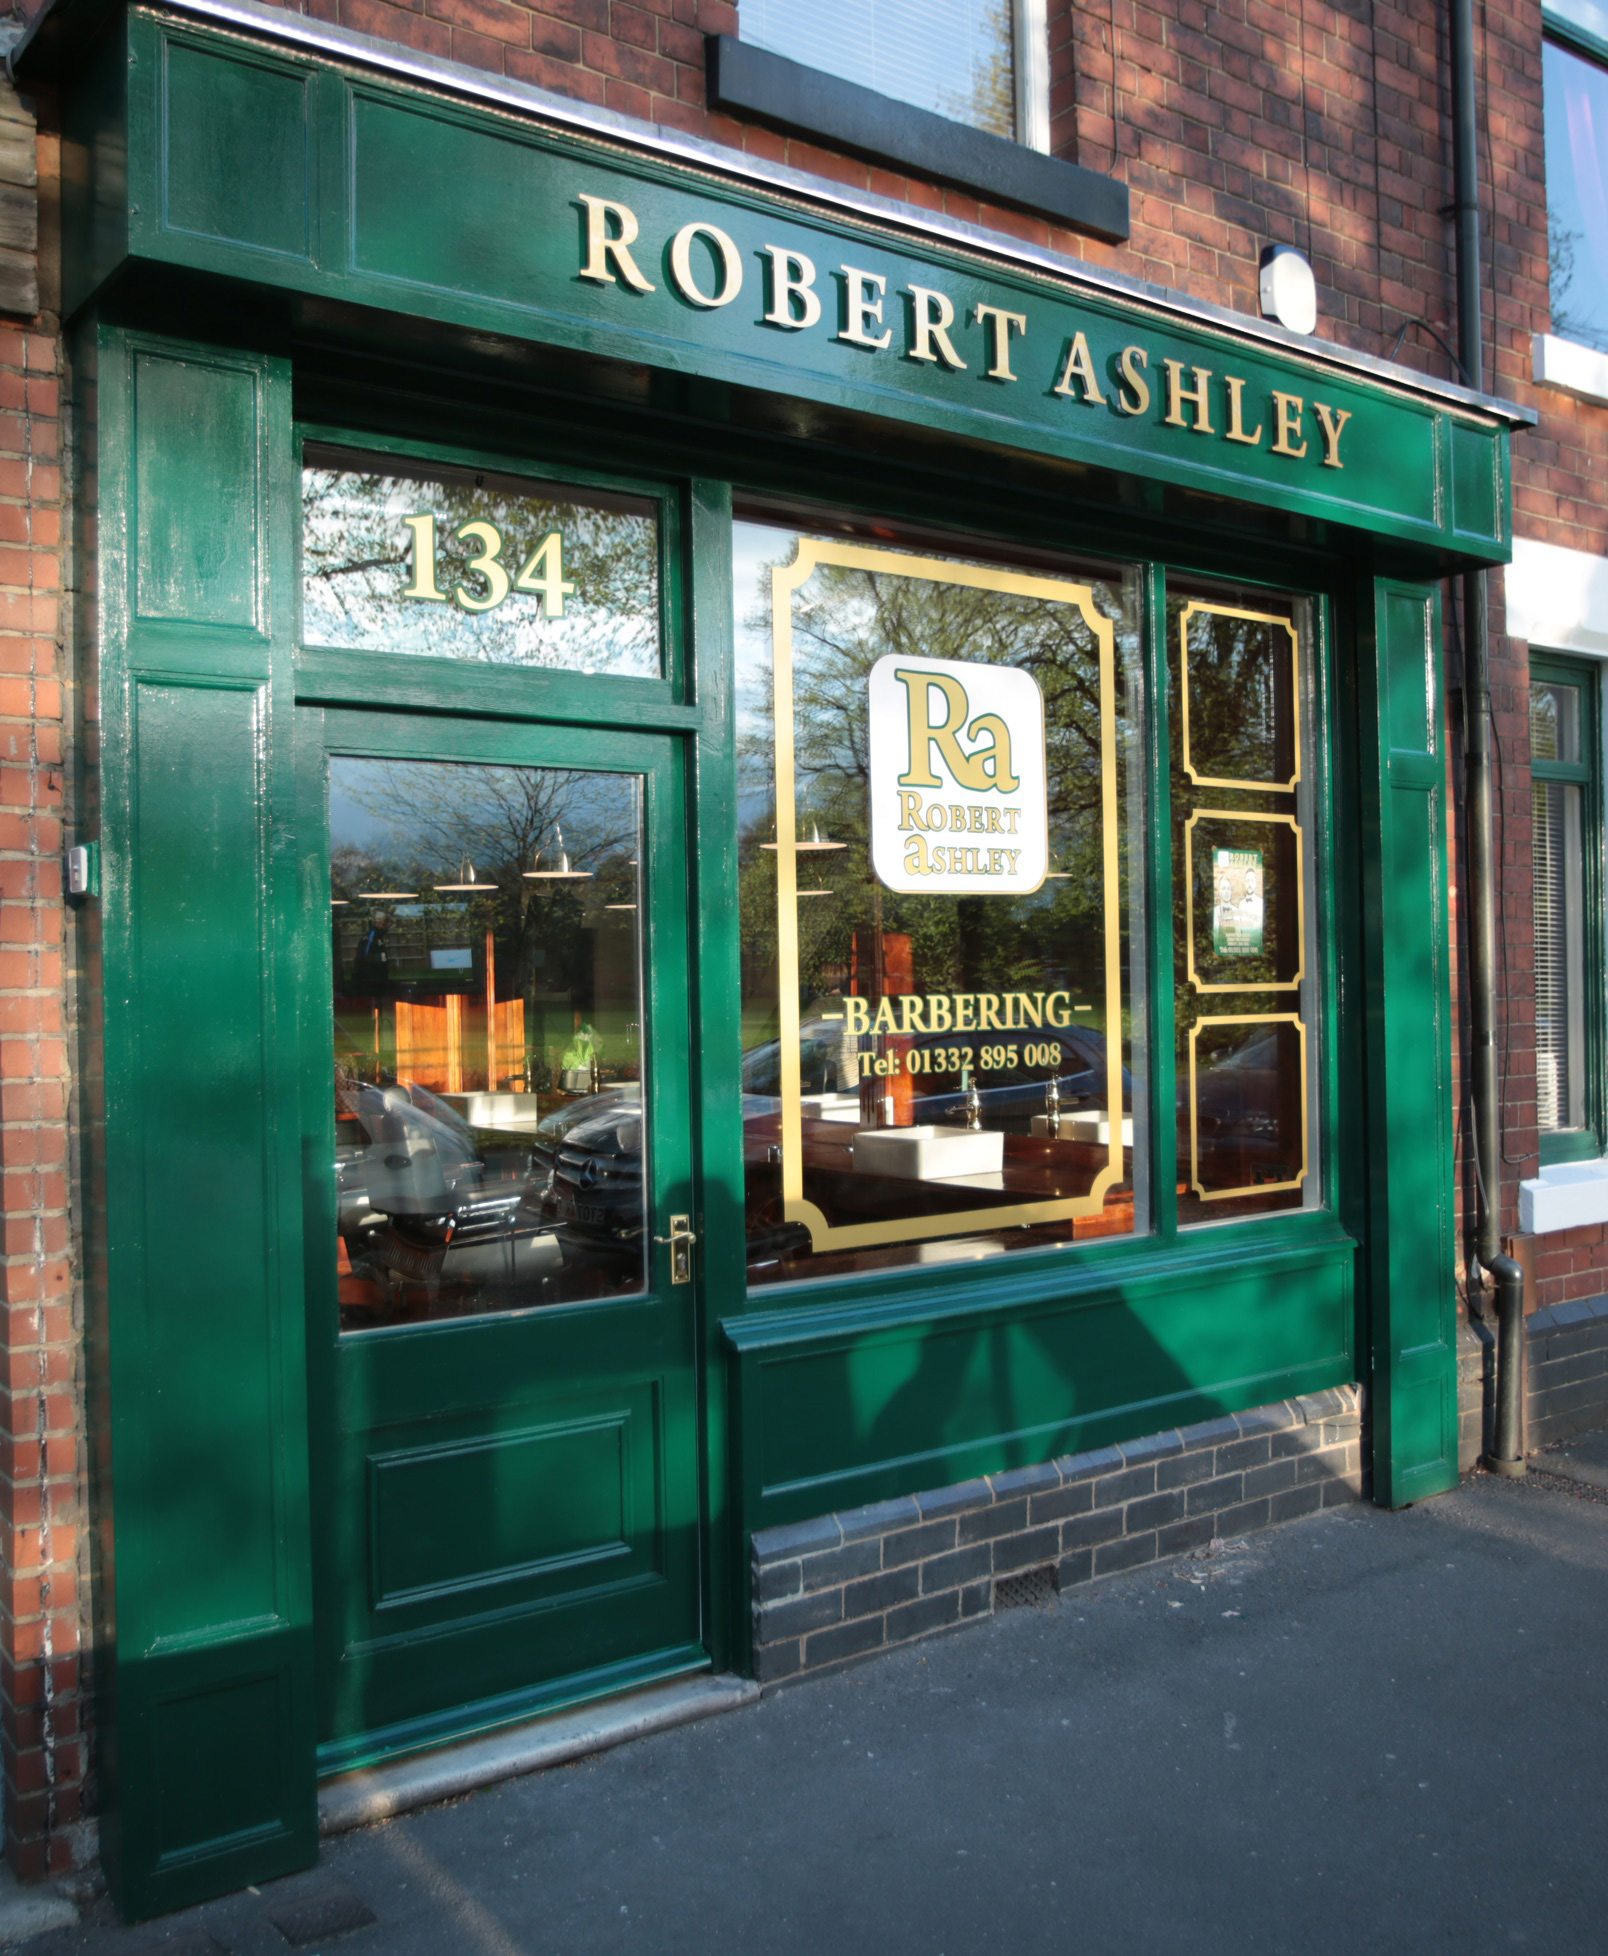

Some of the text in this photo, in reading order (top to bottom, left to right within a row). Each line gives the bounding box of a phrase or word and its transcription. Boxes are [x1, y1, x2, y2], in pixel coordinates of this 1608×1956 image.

[577, 193, 1353, 469] ROBERT ASHLEY
[402, 512, 579, 620] 134
[894, 668, 1020, 794] Ra
[897, 790, 1021, 834] ROBERT
[858, 1042, 1062, 1077] Tel: 01332 895 008
